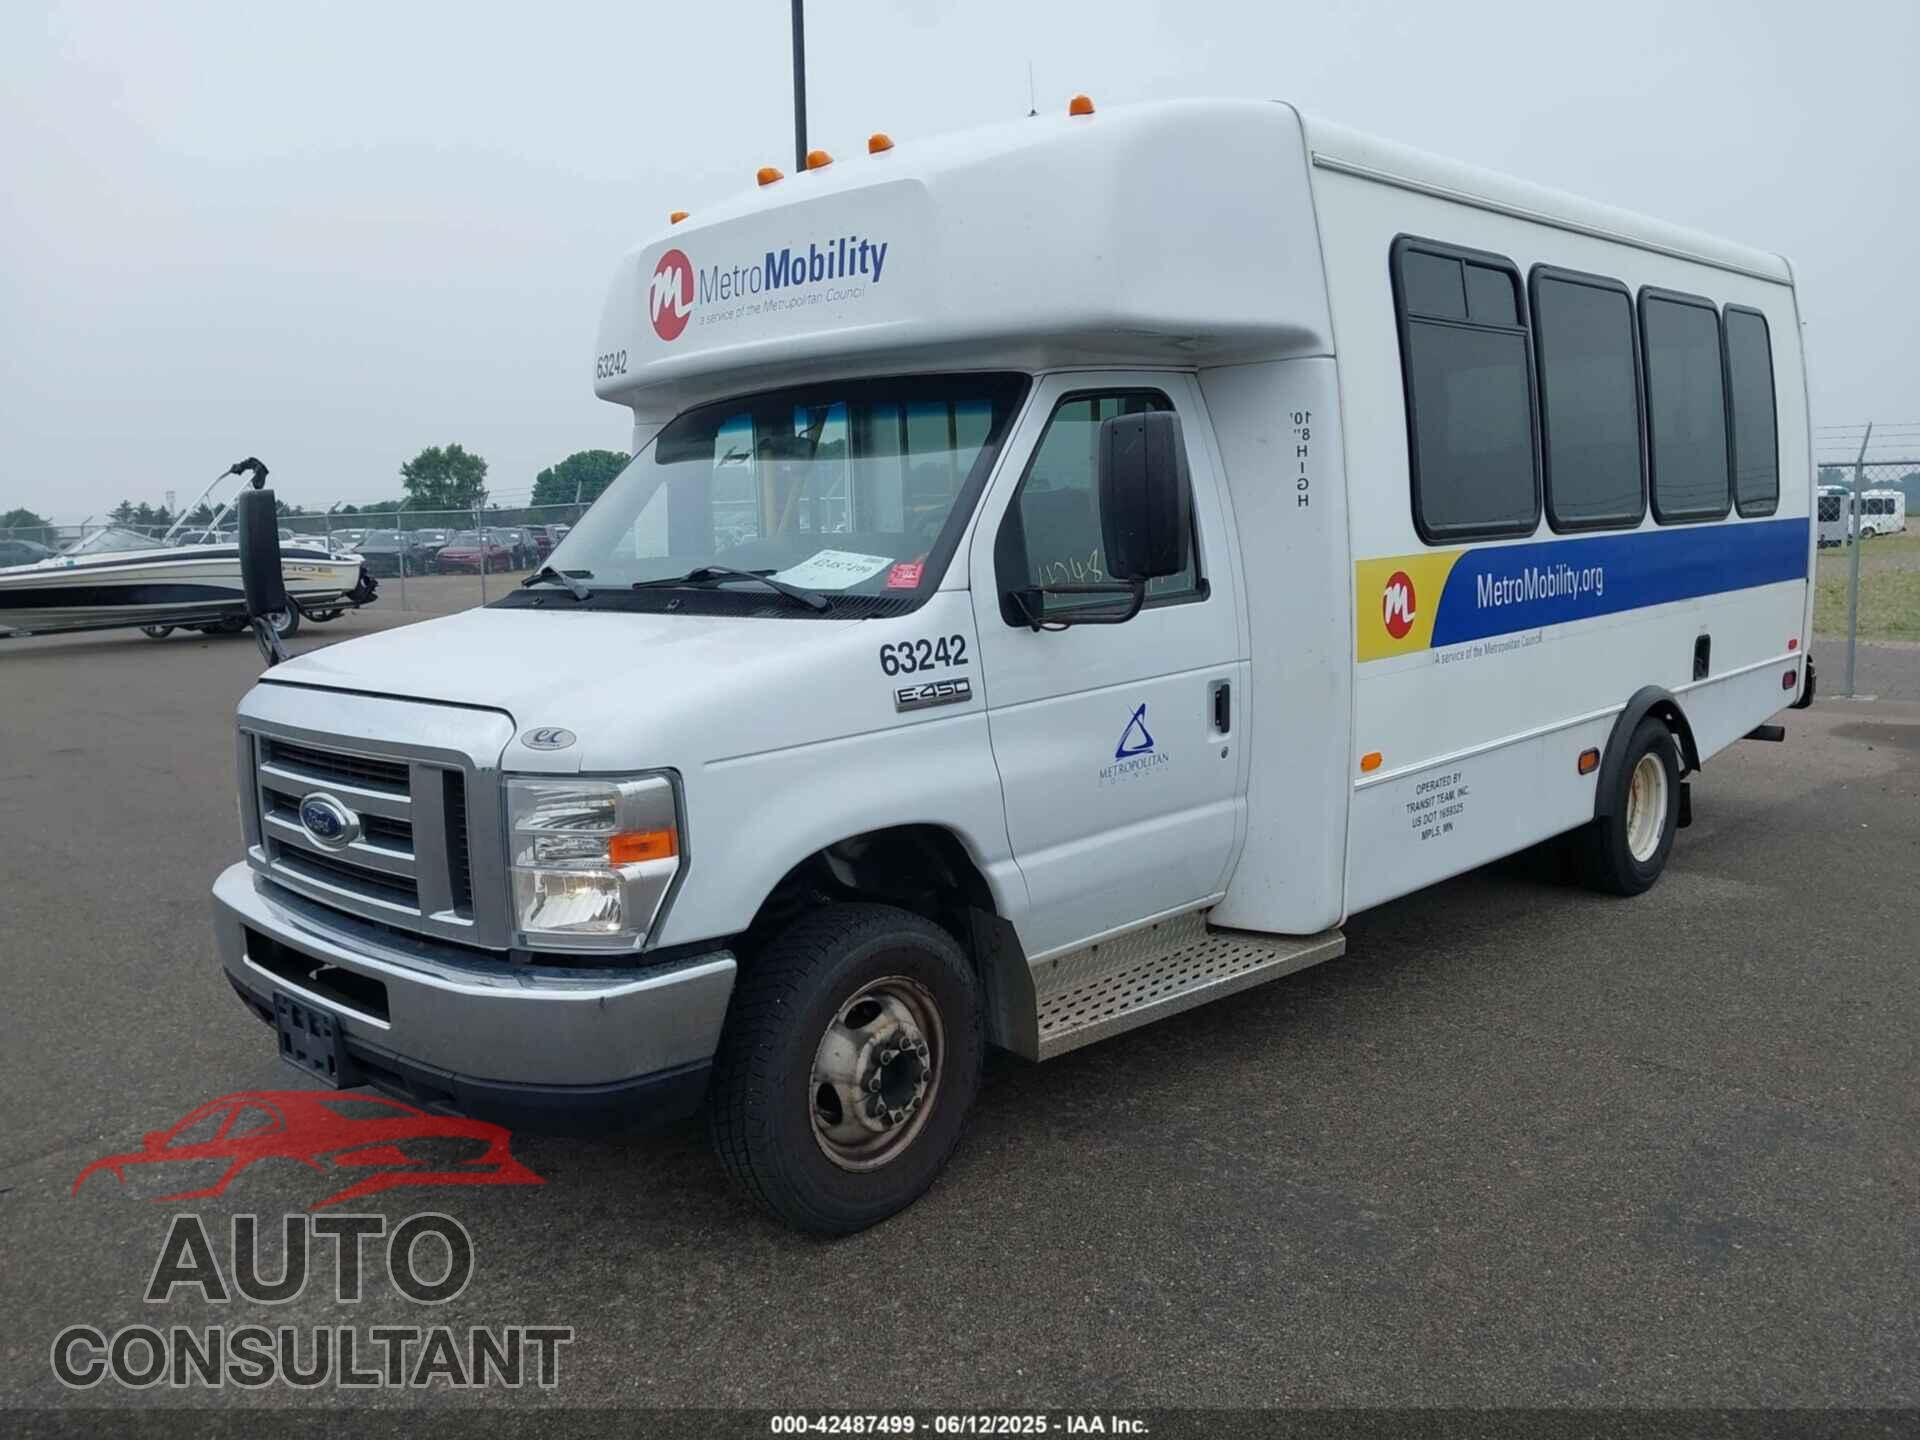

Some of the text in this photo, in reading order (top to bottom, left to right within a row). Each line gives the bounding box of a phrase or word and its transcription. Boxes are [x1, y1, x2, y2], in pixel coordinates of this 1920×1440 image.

[699, 236, 888, 305] MetroMobility
[706, 309, 734, 325] service
[735, 305, 746, 318] of
[747, 302, 761, 315] the
[762, 292, 823, 313] Metropolitan
[826, 286, 865, 302] Council
[596, 349, 628, 379] 63242
[1476, 566, 1604, 609] MetroMobility.org
[879, 633, 969, 677] 63242
[1441, 649, 1465, 665] service
[1465, 645, 1473, 659] of
[1473, 645, 1483, 658] the
[1484, 639, 1521, 656] Metropolitan
[1521, 628, 1543, 648] Council
[896, 678, 971, 703] E-450
[1099, 752, 1169, 779] METROPOLITAN
[1415, 772, 1462, 795] OPERATED BY
[1406, 795, 1436, 814] TRANSIT
[1436, 790, 1456, 804] TEAM
[1411, 815, 1422, 829] US
[1422, 810, 1438, 825] DOT
